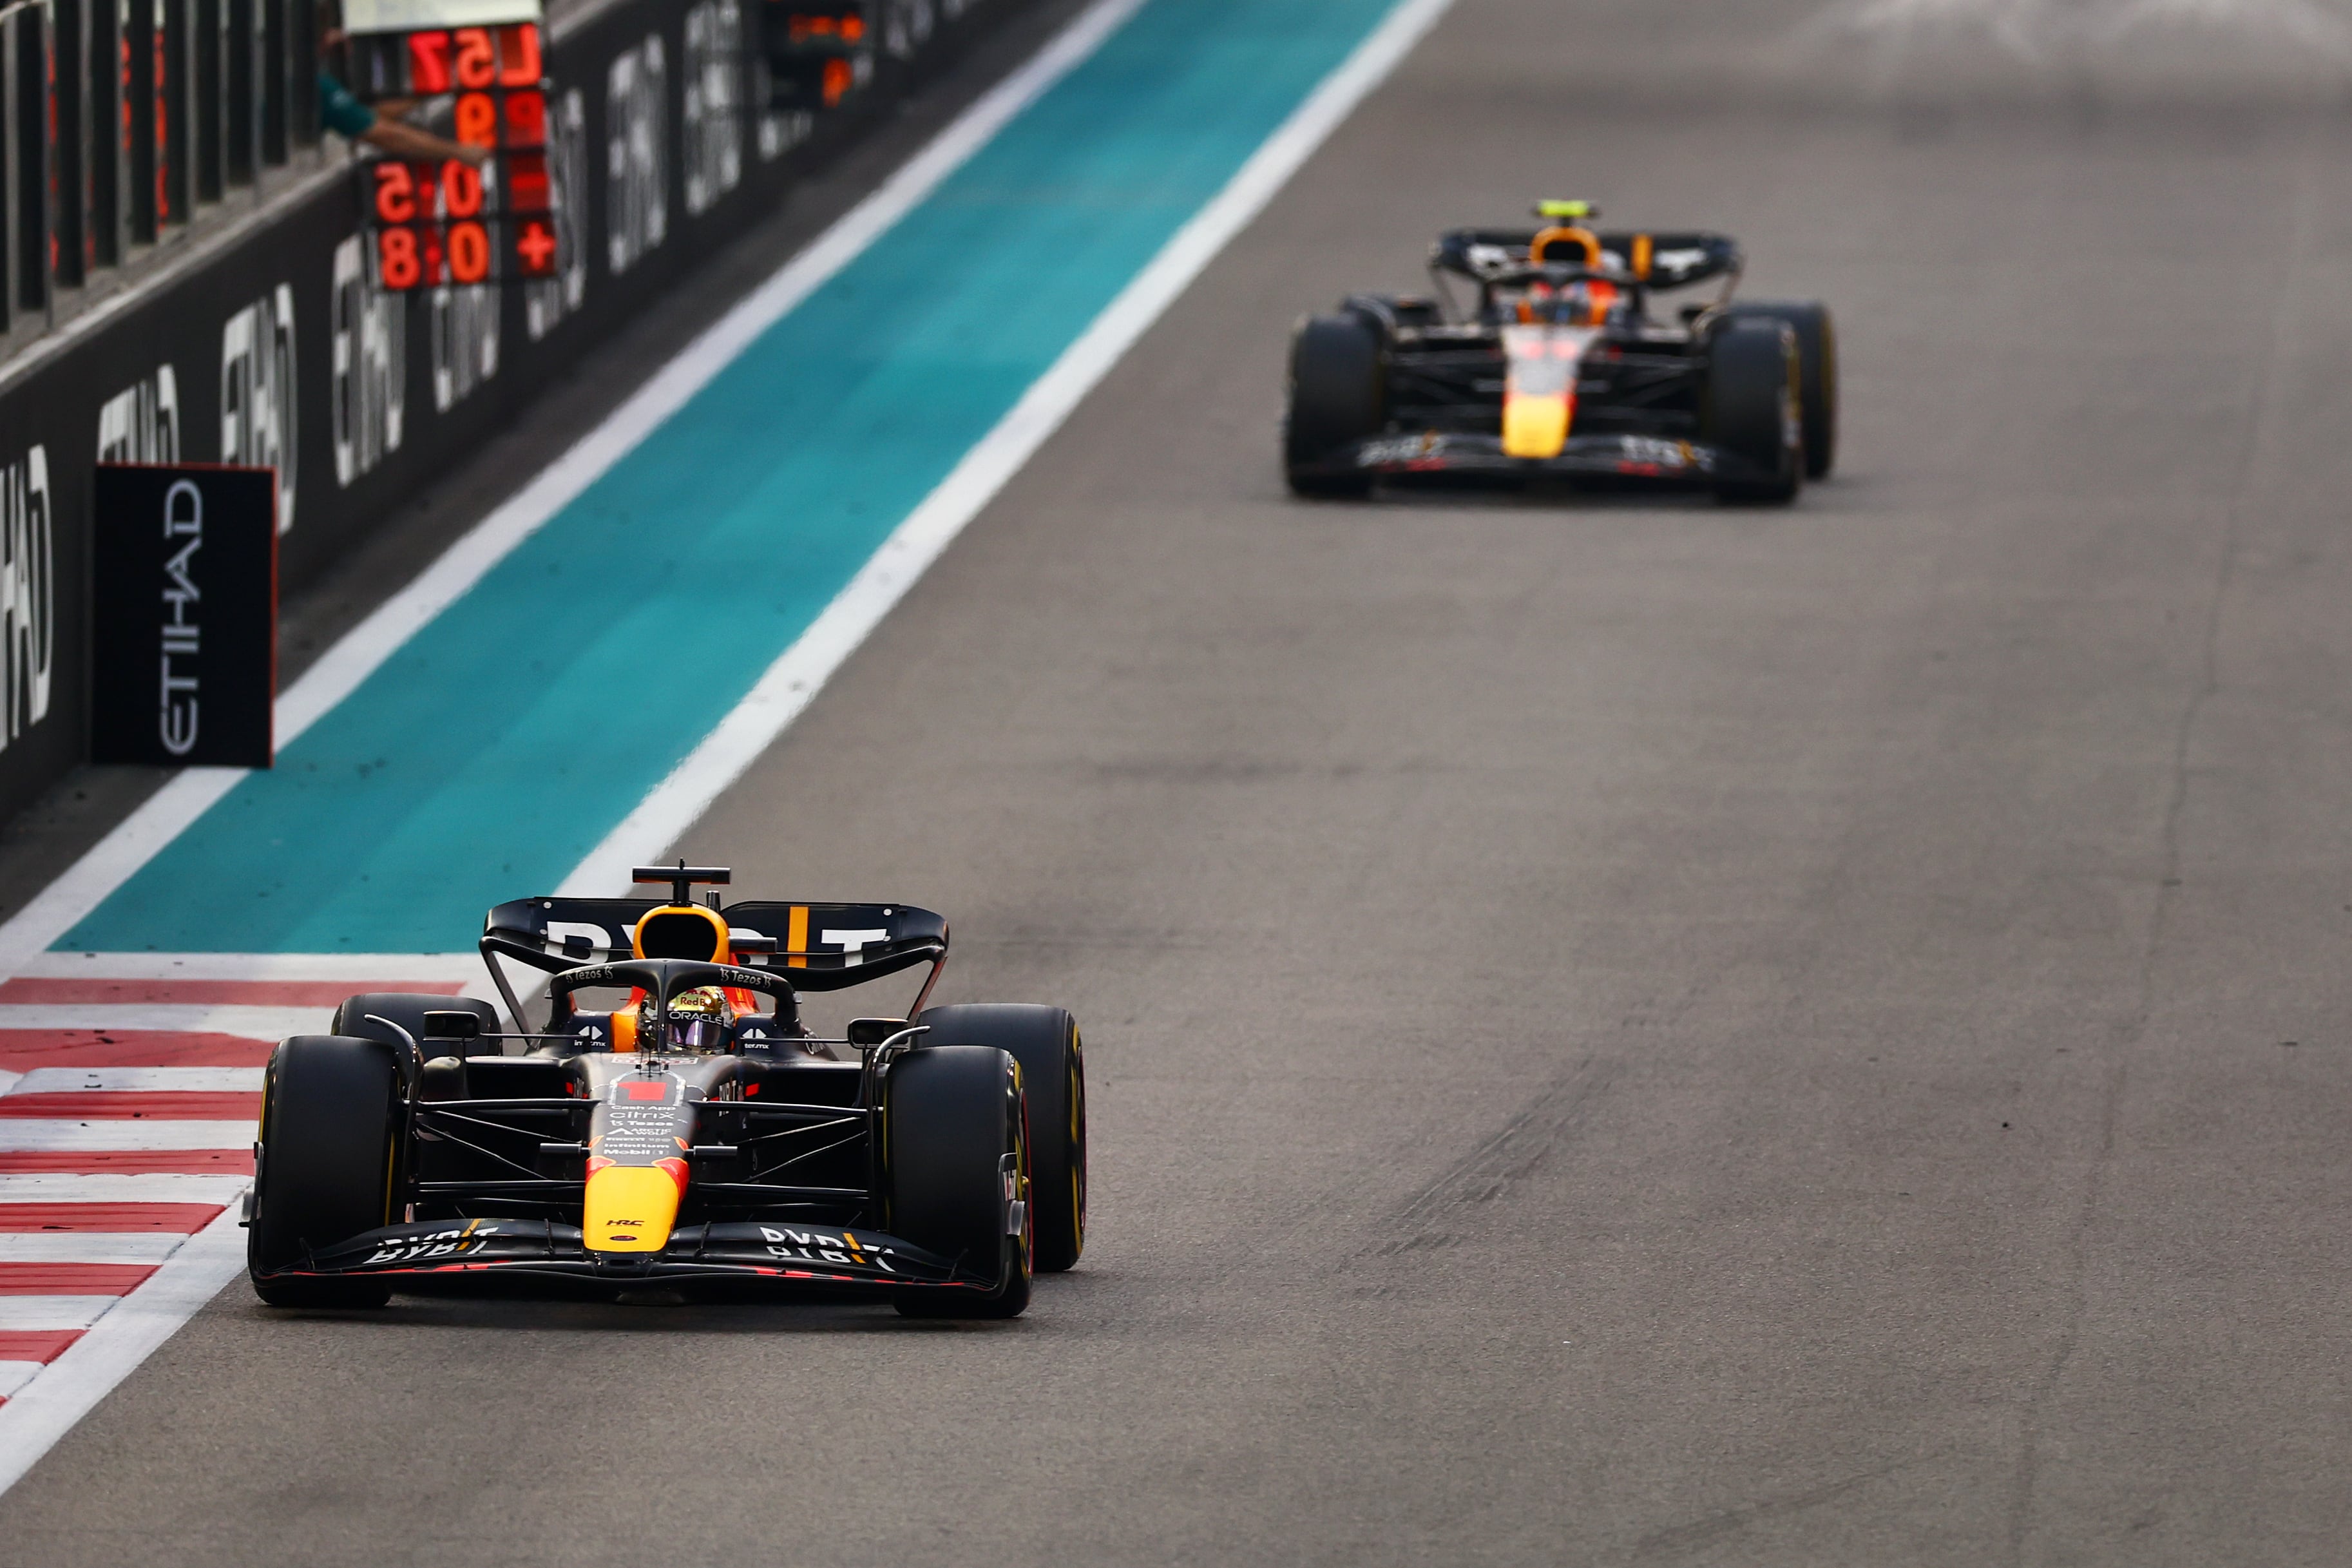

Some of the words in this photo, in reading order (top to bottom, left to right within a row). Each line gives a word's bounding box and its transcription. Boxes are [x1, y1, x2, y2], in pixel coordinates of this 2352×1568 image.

[159, 479, 203, 754] ETIHAD
[544, 906, 888, 968] BIT
[731, 970, 761, 985] Tezos
[680, 997, 698, 1006] Red
[669, 1011, 723, 1025] ORACLE
[618, 1082, 667, 1101] 1
[362, 1218, 499, 1265] BYBIT
[759, 1227, 896, 1273] BYBIT
